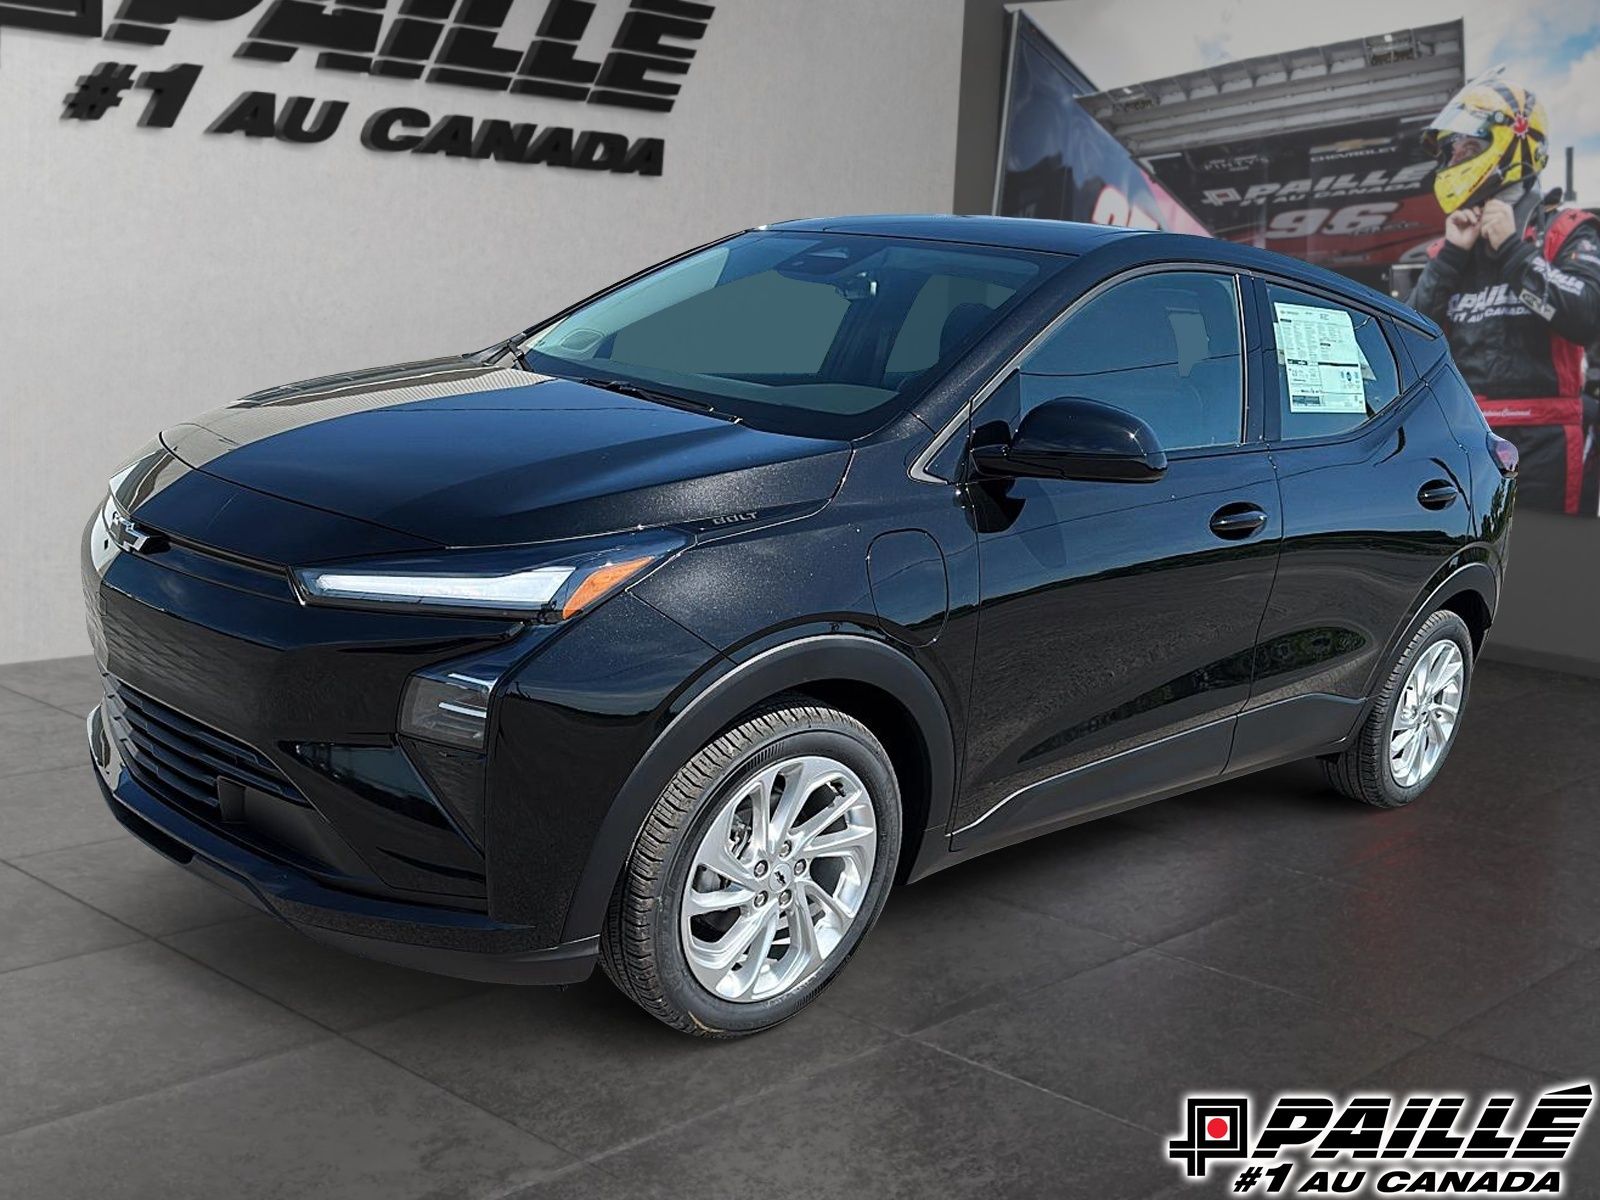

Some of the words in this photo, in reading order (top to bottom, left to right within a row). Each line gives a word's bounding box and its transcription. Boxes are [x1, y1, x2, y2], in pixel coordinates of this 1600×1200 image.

[60, 61, 203, 128] #1
[204, 91, 349, 143] AU
[360, 107, 665, 176] CANADA
[1310, 146, 1398, 163] CHEVROLET
[1314, 181, 1421, 199] CANADA
[1264, 202, 1399, 239] 96
